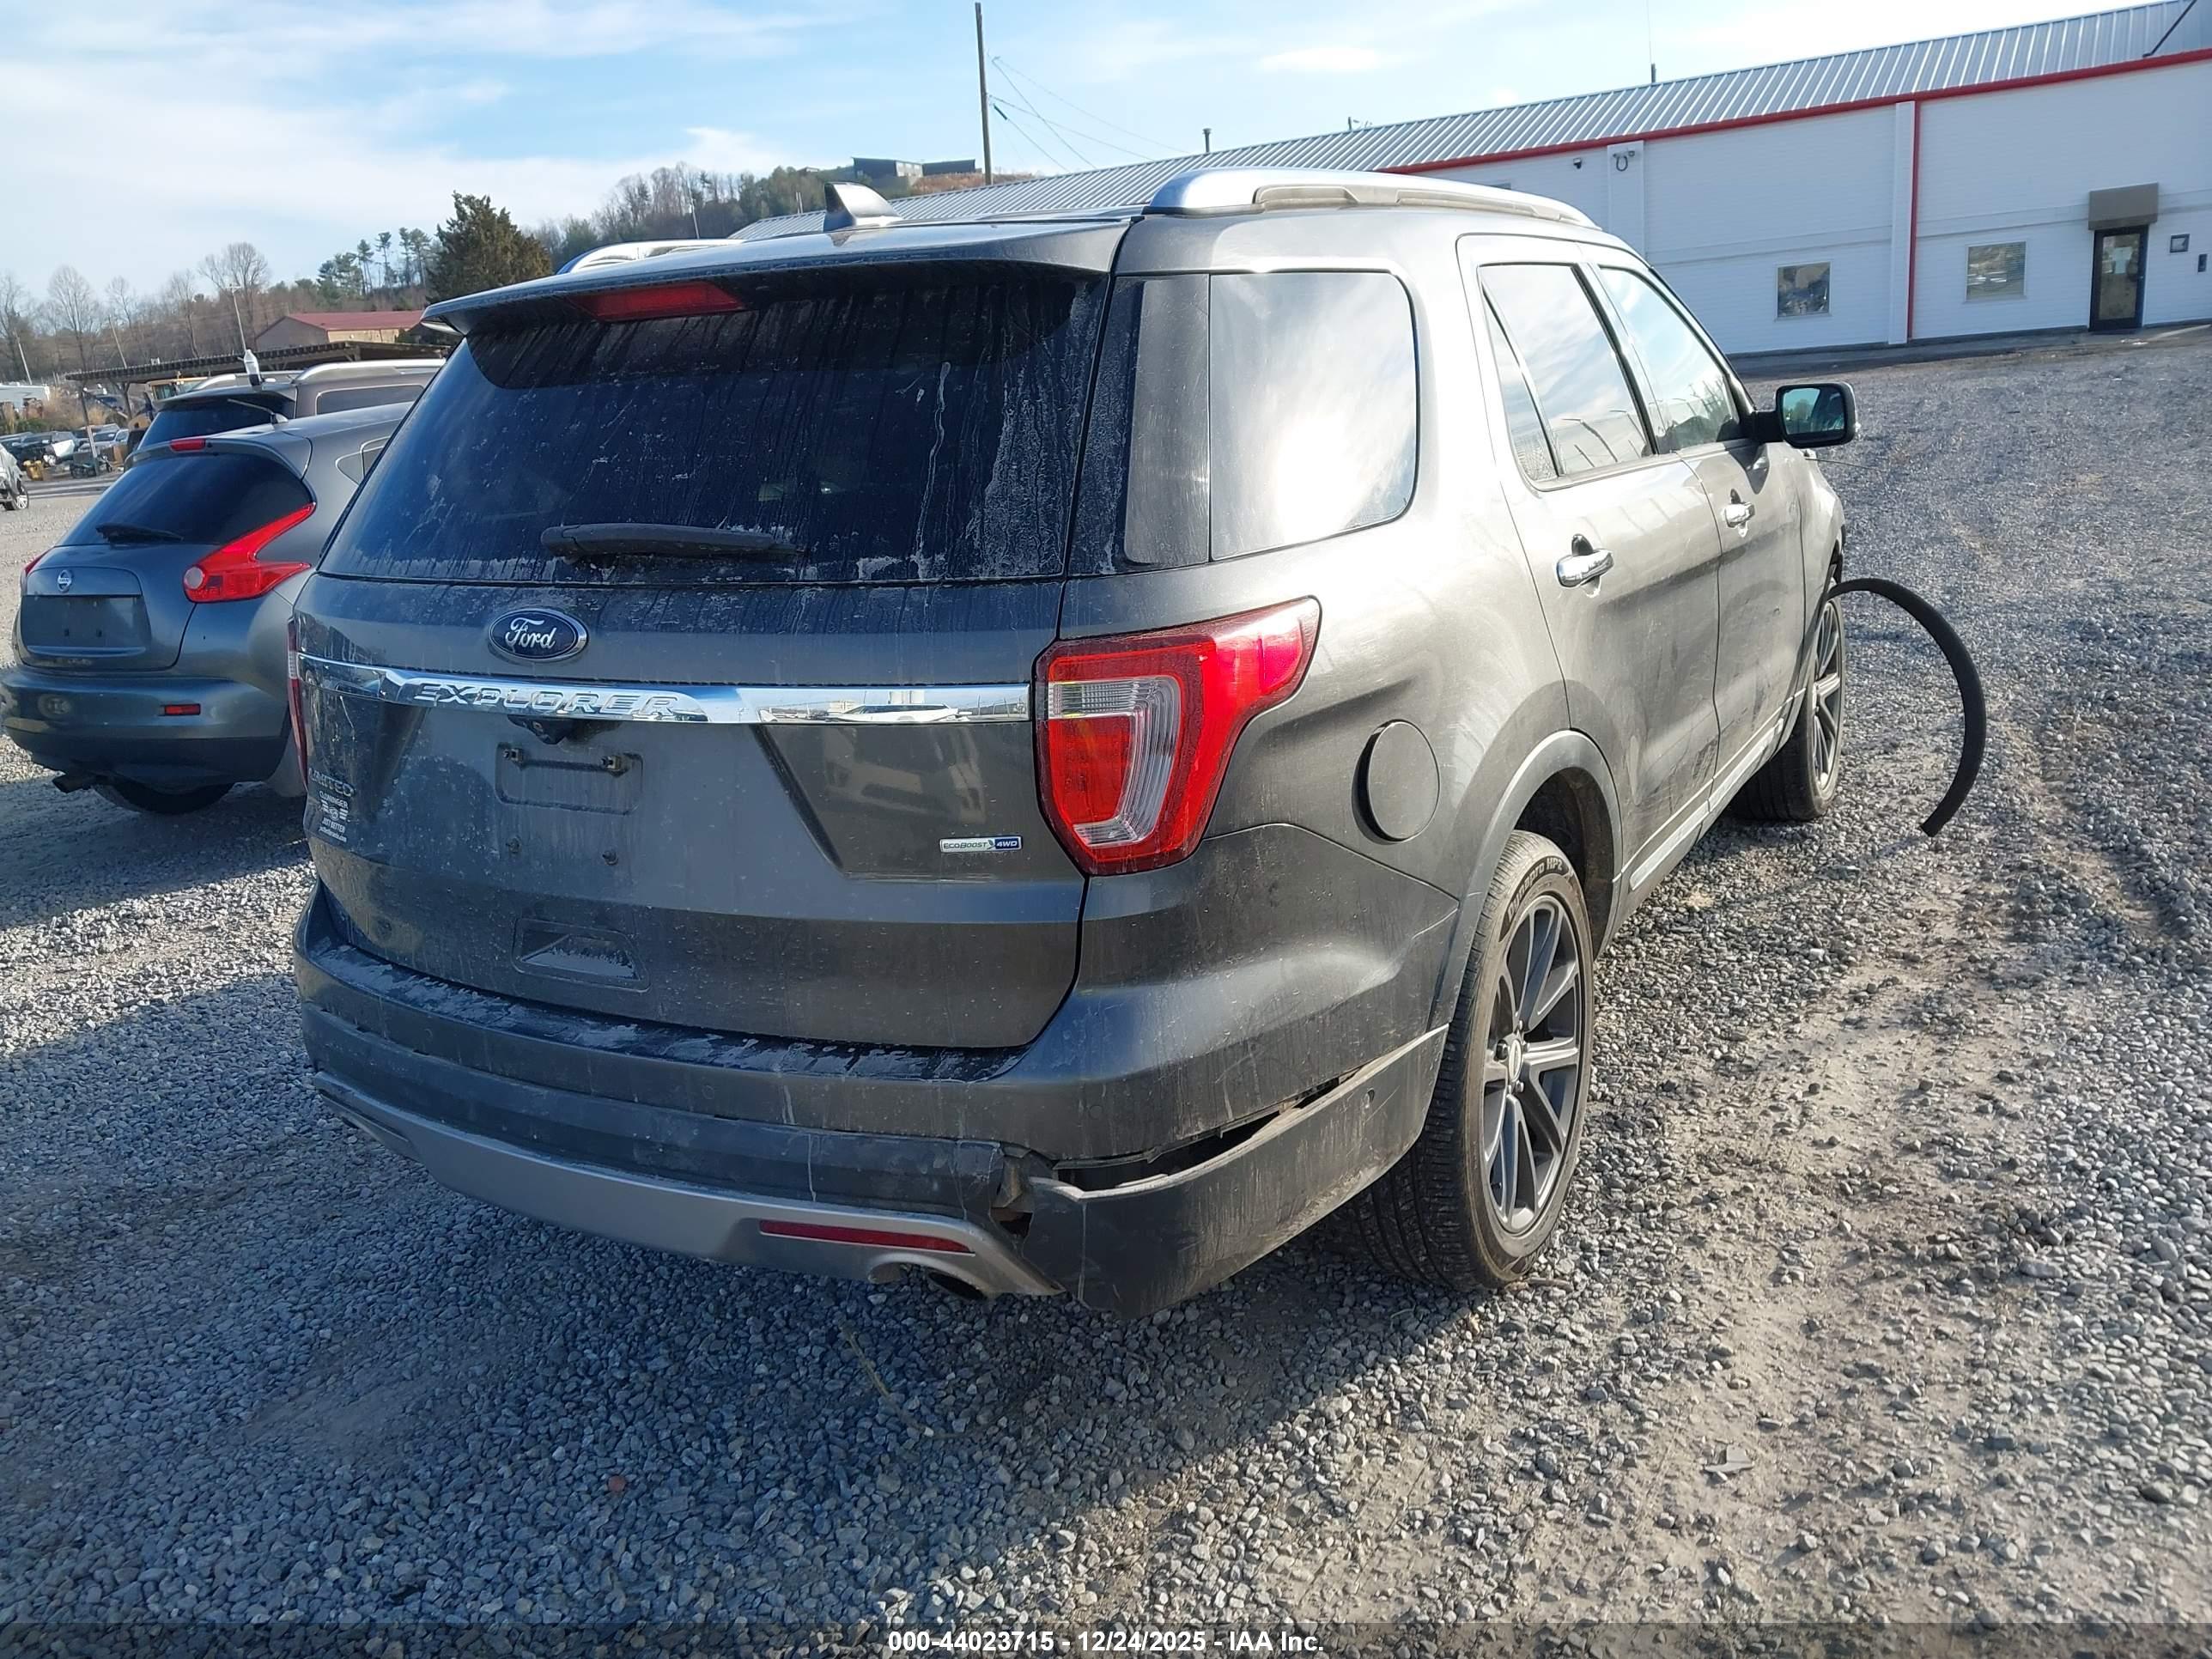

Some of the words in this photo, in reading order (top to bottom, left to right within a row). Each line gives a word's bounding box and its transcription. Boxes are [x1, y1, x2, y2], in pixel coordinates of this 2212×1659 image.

[505, 617, 556, 648] Ford
[414, 683, 678, 717] EXPLORER
[1547, 857, 1563, 871] HP2
